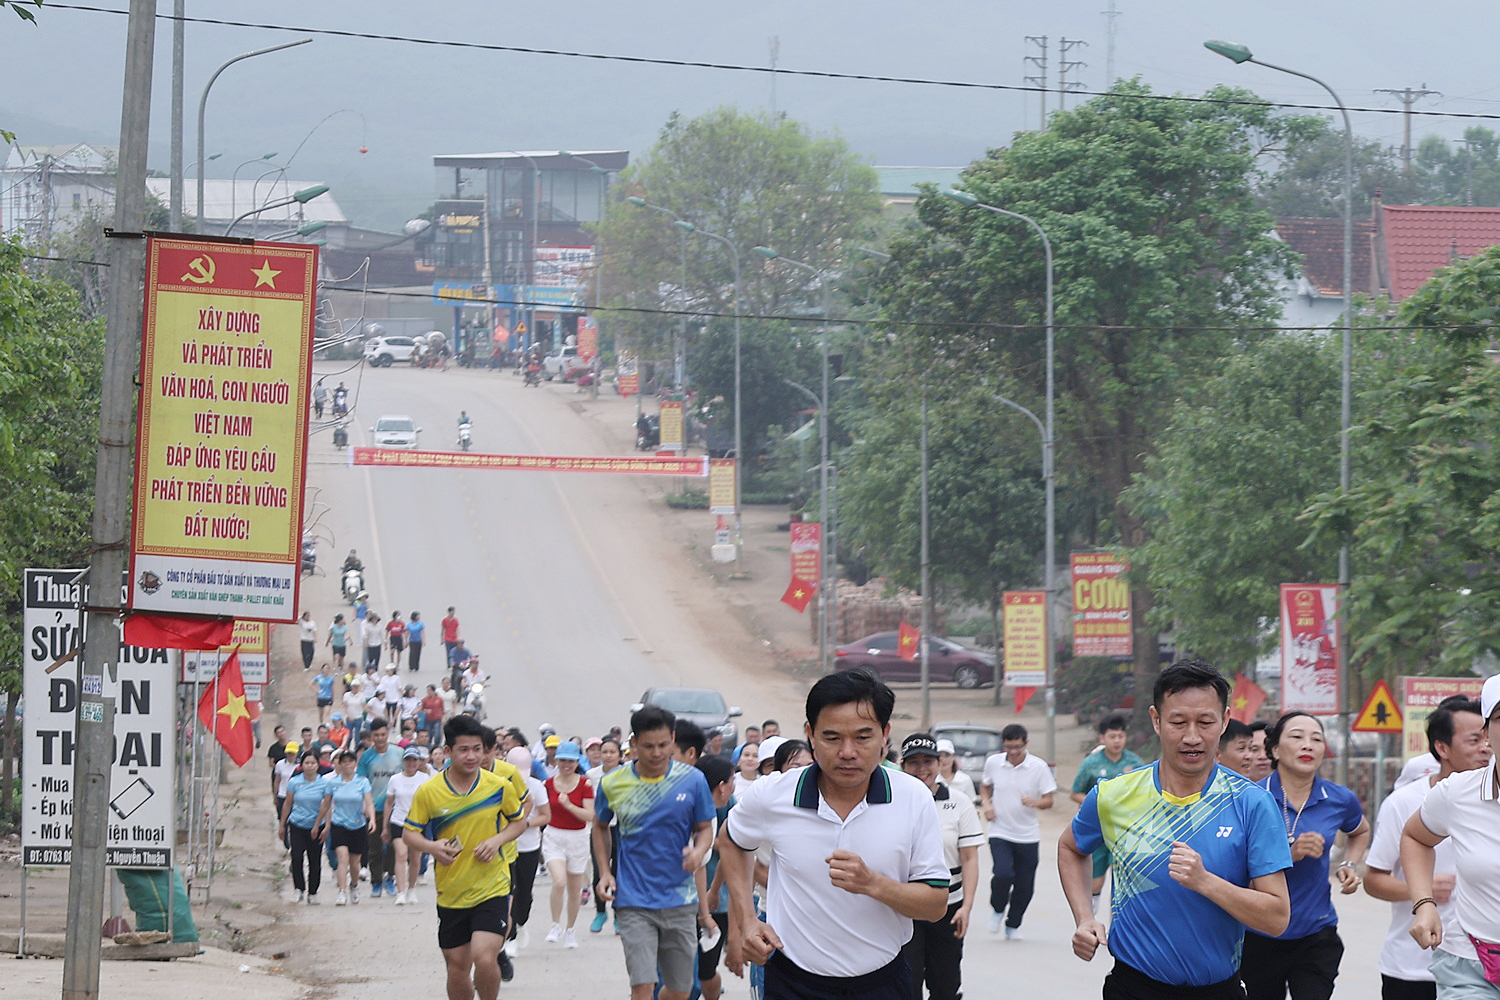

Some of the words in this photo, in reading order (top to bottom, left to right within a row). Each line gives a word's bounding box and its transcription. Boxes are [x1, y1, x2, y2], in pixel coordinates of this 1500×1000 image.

[198, 306, 224, 332] XÂY
[226, 310, 260, 337] DỰNG
[182, 339, 198, 364] VÀ
[202, 341, 234, 367] PHÁT
[237, 340, 273, 369] TRIỂN
[162, 372, 186, 398] VĂN
[190, 375, 218, 402] HOÁ,
[222, 380, 248, 402] CON
[251, 378, 290, 405] NGƯỜI
[194, 410, 220, 439] VIỆT
[223, 415, 252, 437] NAM
[167, 442, 192, 468] ĐÁP
[196, 442, 221, 470] ỨNG
[225, 446, 248, 471] YÊU
[252, 446, 276, 473] CẦU
[152, 476, 184, 501] PHÁT
[187, 475, 222, 504] TRIỂN
[226, 478, 250, 505] BỀN
[254, 481, 287, 508] VỮNG
[185, 510, 208, 537] ĐẤT
[212, 513, 250, 540] NƯỚC!
[167, 569, 180, 583] CÔNG
[180, 571, 186, 583] TY
[187, 568, 193, 584] CỔ
[224, 570, 234, 586] SẢN
[234, 572, 246, 586] XUẤT
[272, 578, 281, 591] MẠI
[1075, 576, 1129, 611] CƠM
[48, 678, 150, 715] ĐN
[36, 730, 162, 775] THẠI
[41, 777, 69, 793] Mua
[41, 796, 56, 816] Ép
[41, 822, 61, 840] Mở
[108, 825, 128, 844] iện
[132, 825, 165, 845] thoại
[30, 850, 42, 863] ĐT:
[44, 850, 63, 863] 0763
[113, 848, 142, 865] Nguyễn
[143, 851, 166, 866] Thuận
